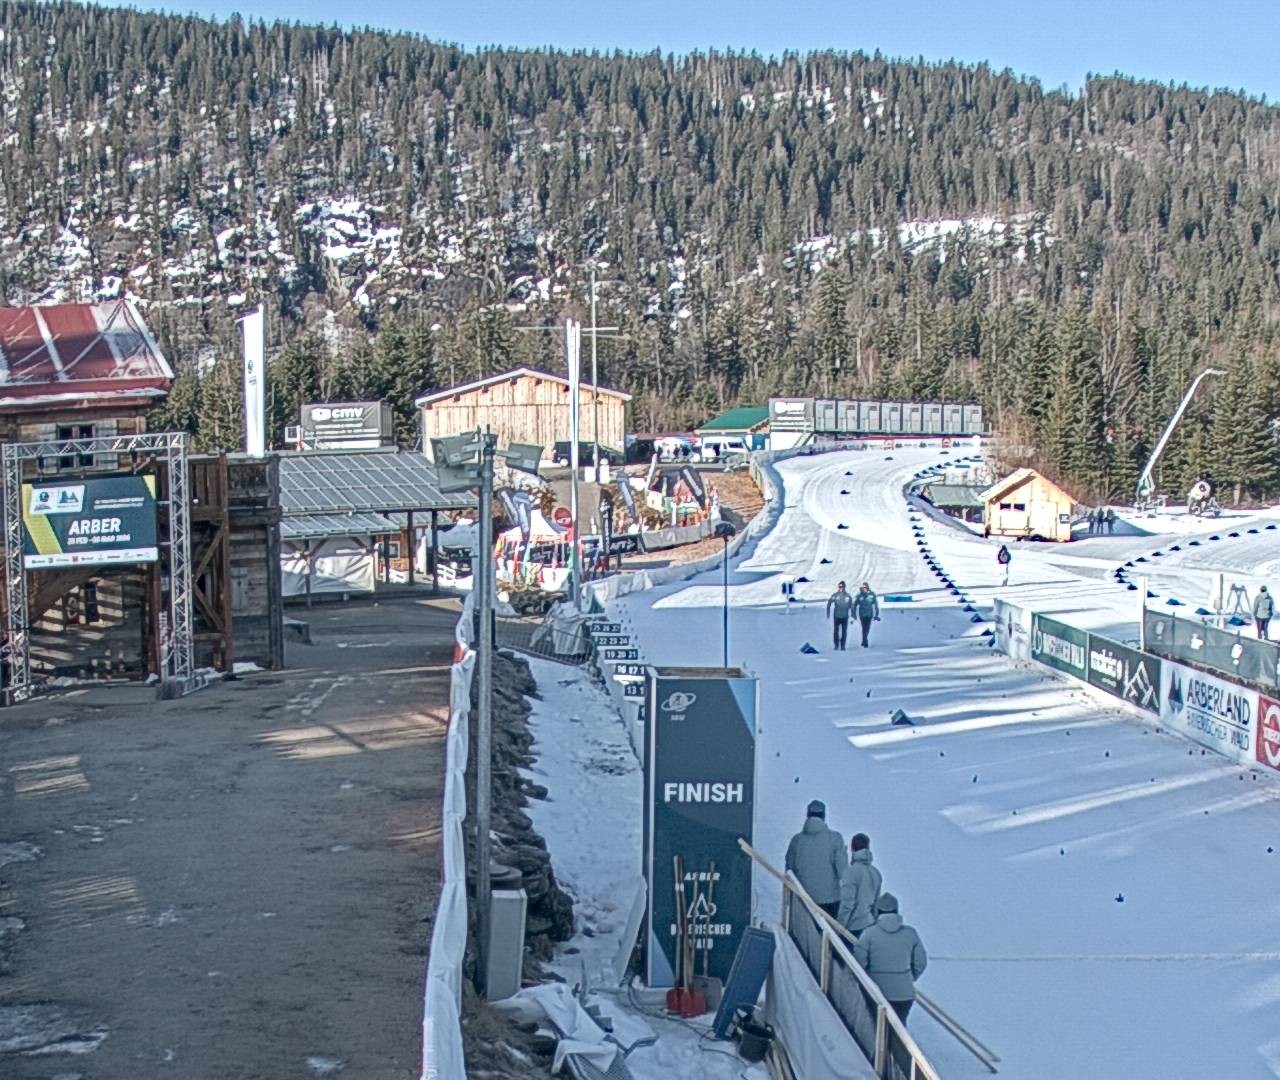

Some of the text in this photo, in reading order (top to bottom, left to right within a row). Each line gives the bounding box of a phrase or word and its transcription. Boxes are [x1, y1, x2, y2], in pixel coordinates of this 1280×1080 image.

[68, 517, 122, 535] ARBER
[627, 686, 637, 695] 13
[1186, 677, 1251, 727] ARBERLAND
[664, 782, 744, 804] FINISH
